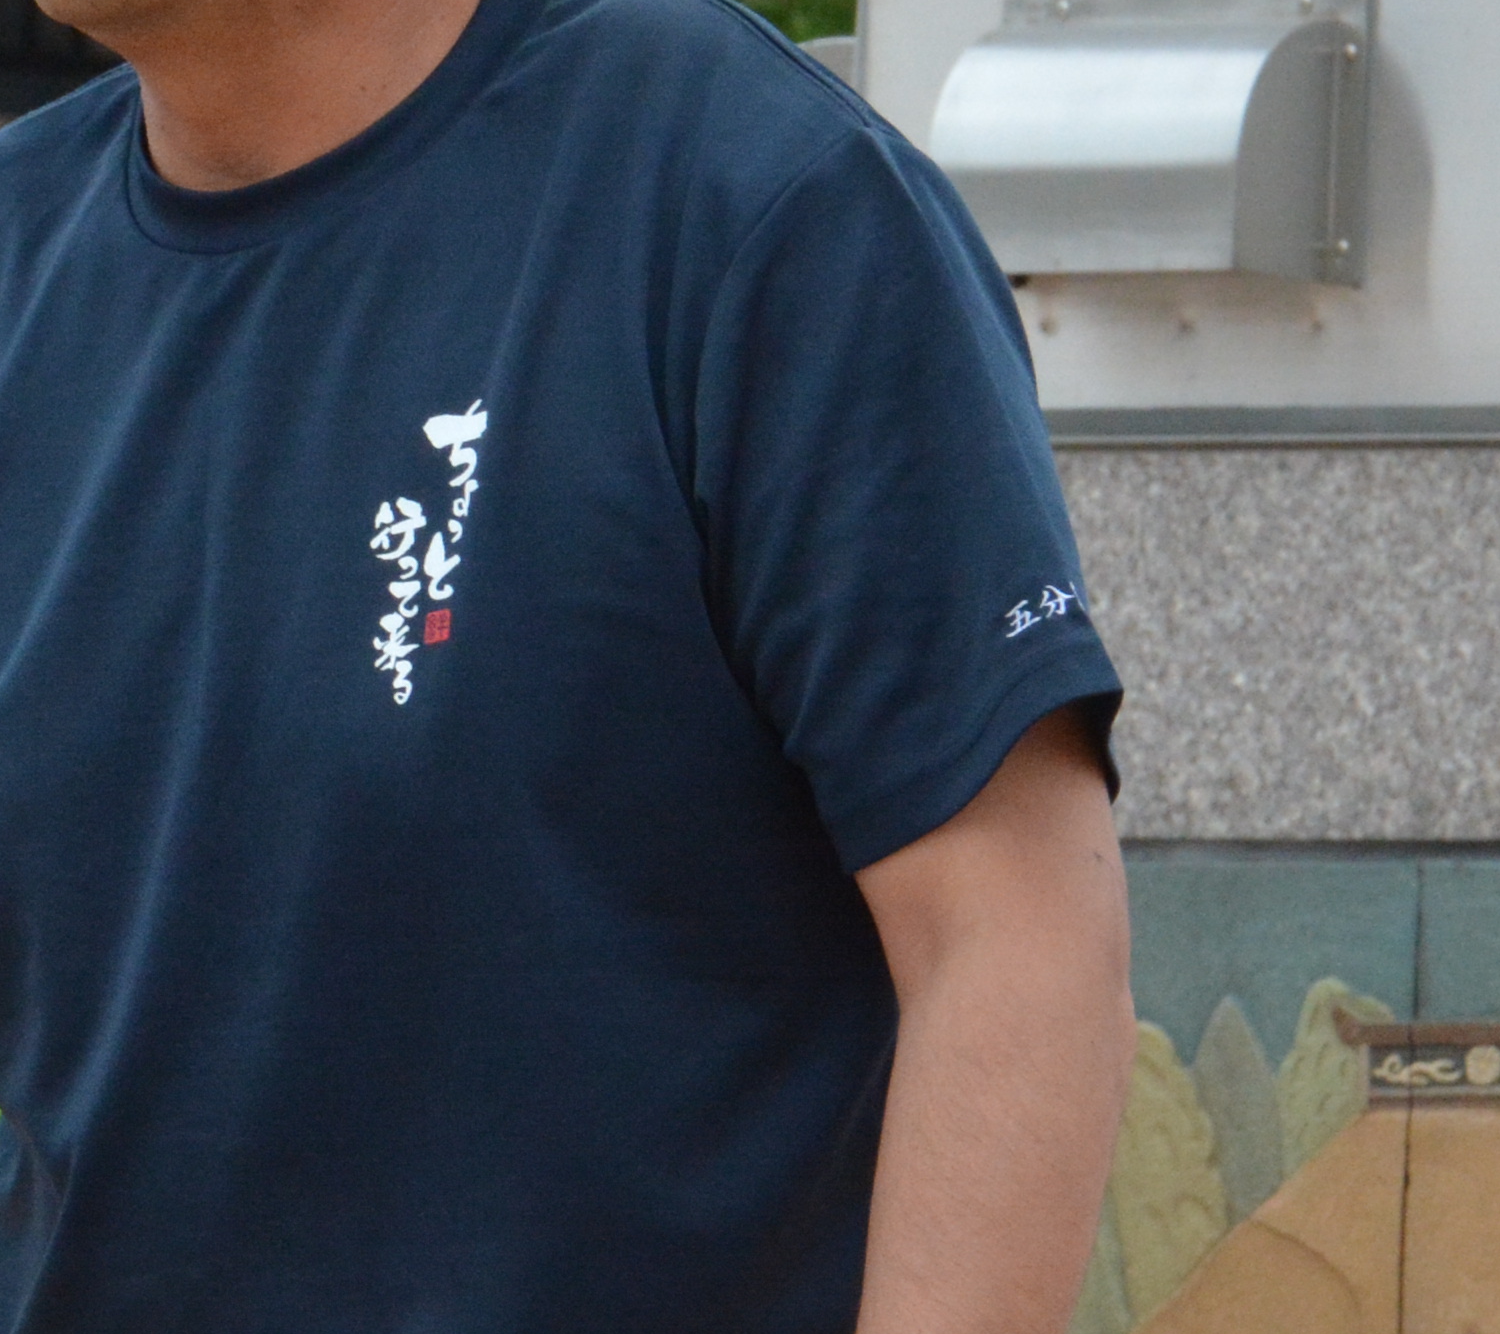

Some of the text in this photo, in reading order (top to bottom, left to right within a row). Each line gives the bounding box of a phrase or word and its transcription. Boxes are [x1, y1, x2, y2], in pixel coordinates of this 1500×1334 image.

[423, 399, 488, 600] ちょっと
[1004, 581, 1086, 638] 五分
